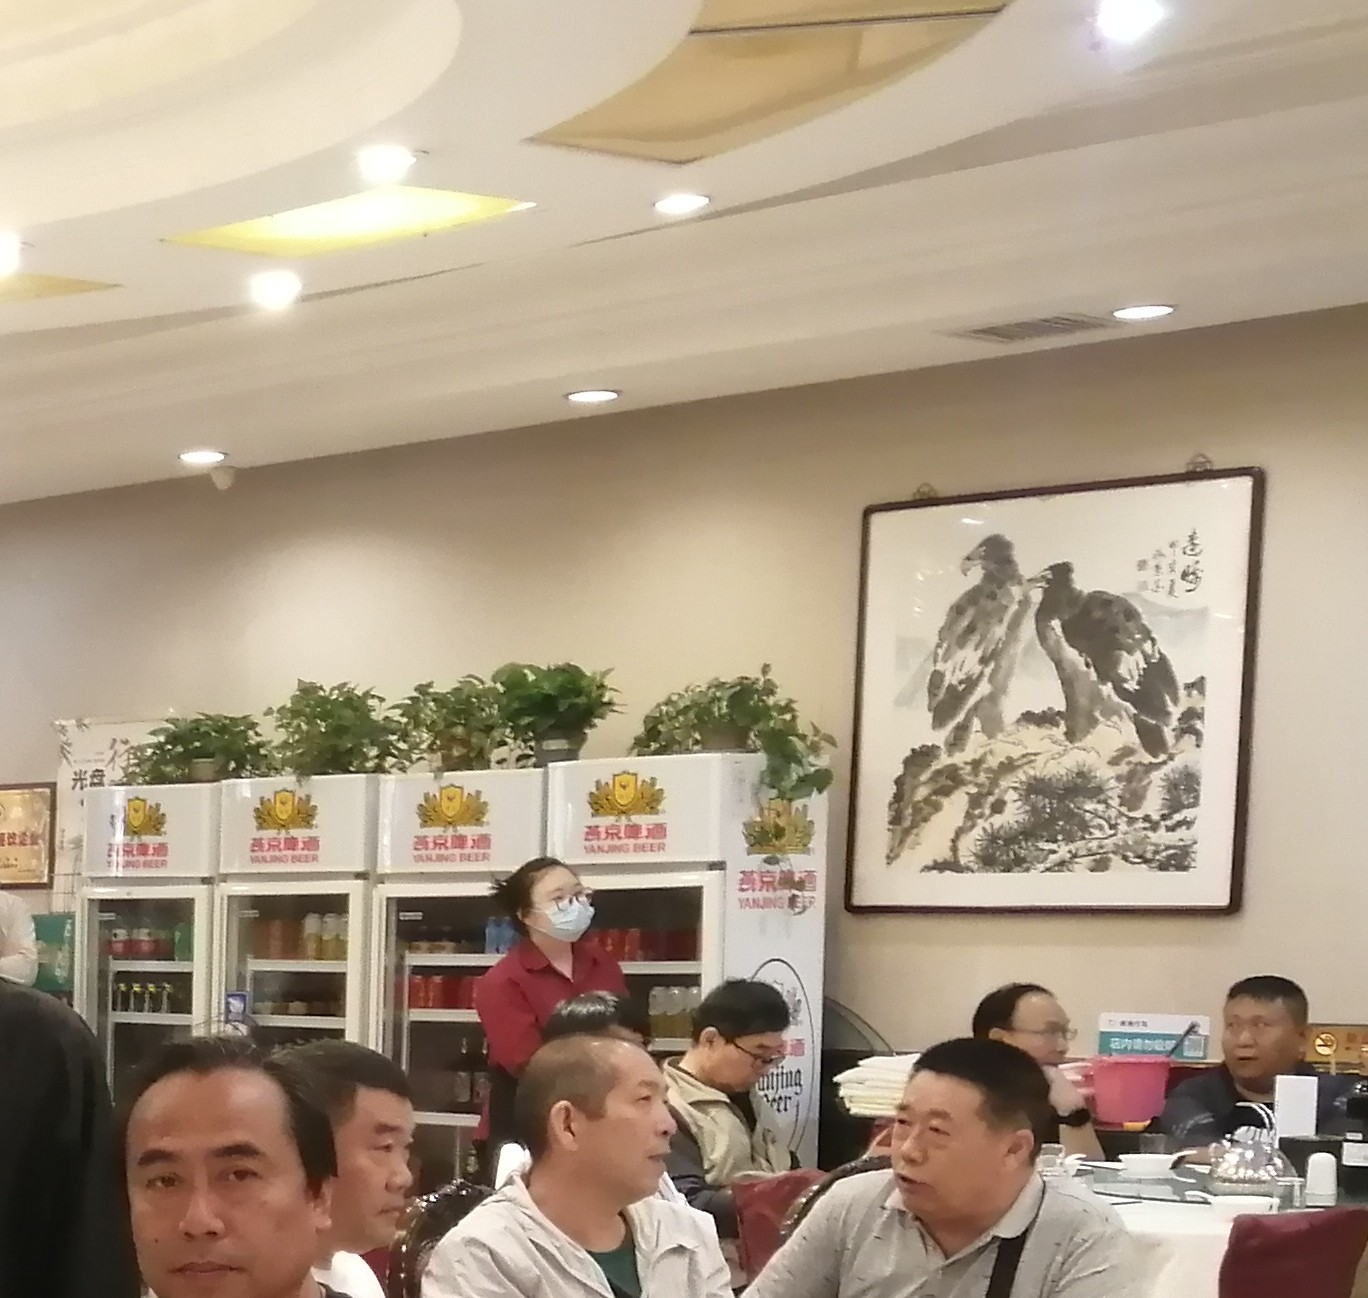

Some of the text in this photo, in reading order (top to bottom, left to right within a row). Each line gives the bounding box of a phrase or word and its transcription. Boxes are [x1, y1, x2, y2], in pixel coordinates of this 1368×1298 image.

[584, 822, 667, 841] 燕京啤酒
[413, 833, 492, 851] 燕京啤酒
[584, 842, 666, 855] YANJING BEER
[249, 853, 319, 865] YANJING BEER
[413, 852, 491, 864] YANJING BEER
